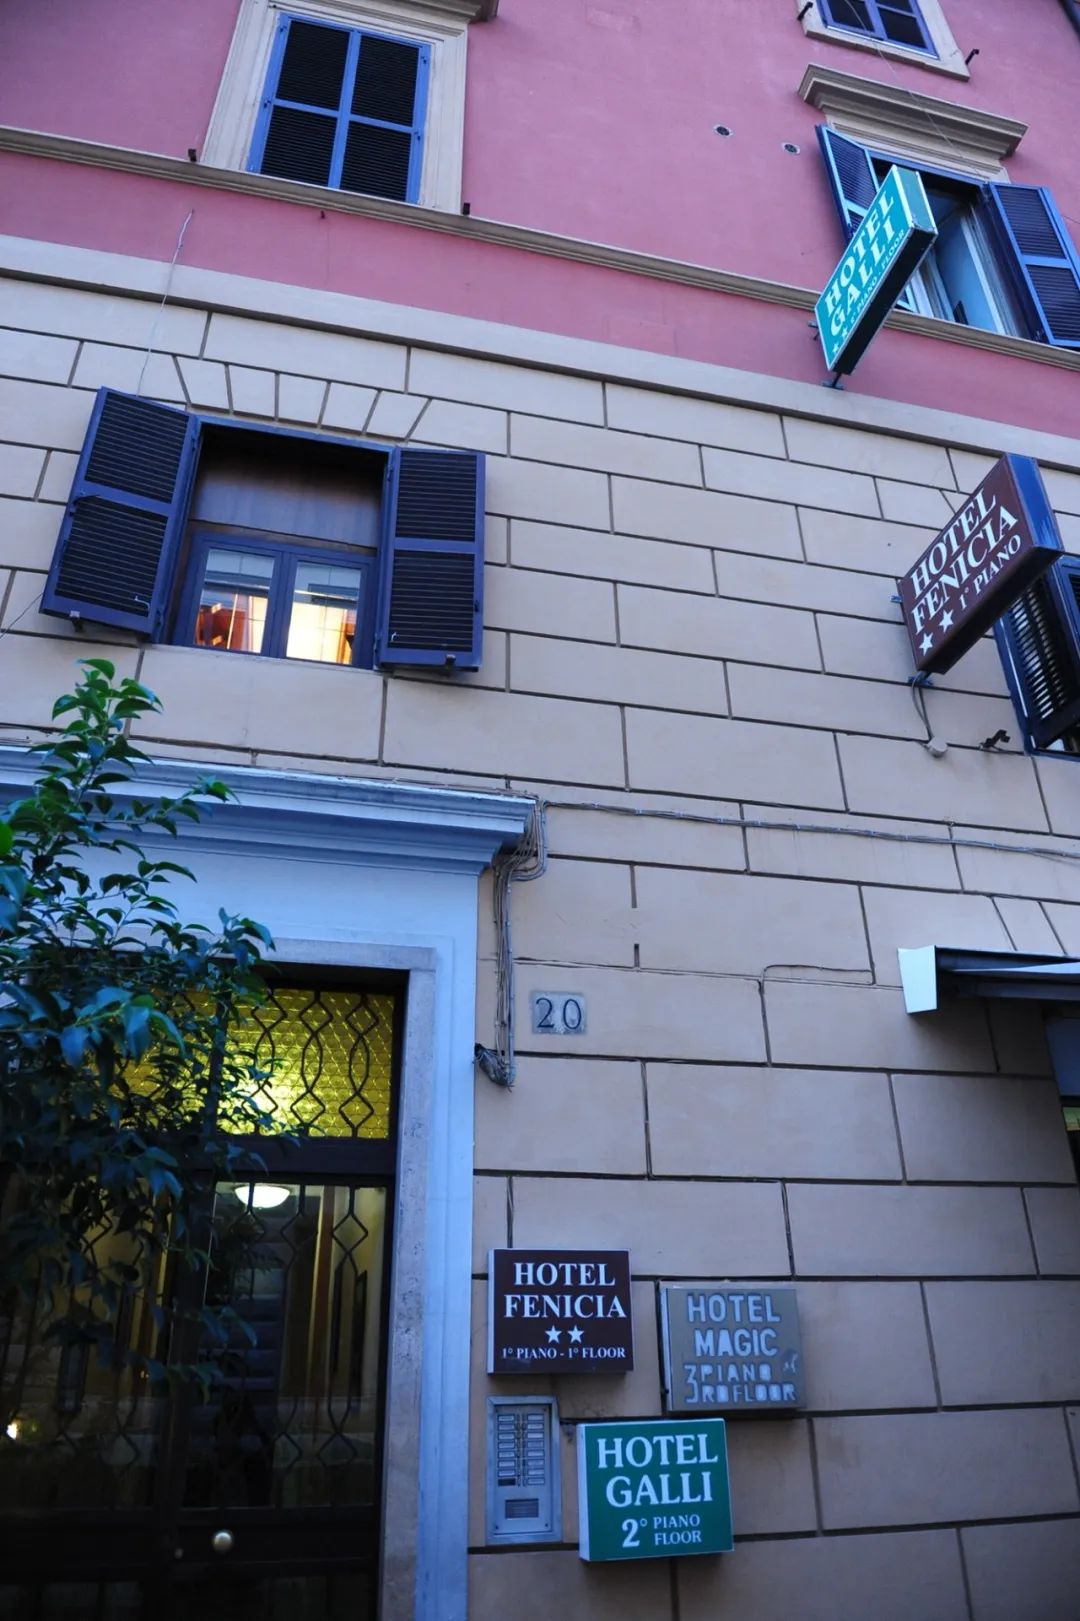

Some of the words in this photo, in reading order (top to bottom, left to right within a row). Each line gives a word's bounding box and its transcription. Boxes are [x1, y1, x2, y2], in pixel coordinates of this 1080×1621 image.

[824, 190, 894, 316] HOTEL
[830, 215, 895, 337] GALLI
[856, 276, 878, 315] PIANO
[881, 228, 905, 270] FLOOR
[911, 488, 996, 599] HOTEL
[911, 505, 1018, 635] FENICIA
[973, 534, 1021, 595] PIANO
[536, 997, 582, 1030] 20
[513, 1262, 616, 1287] HOTEL
[504, 1294, 627, 1319] FENICIA
[687, 1295, 781, 1322] HOTEL
[516, 1347, 557, 1359] PIANO
[582, 1347, 626, 1359] FLOOR
[695, 1328, 778, 1357] MAGIC
[701, 1363, 772, 1382] PIANO
[597, 1433, 719, 1469] HOTEL
[606, 1471, 713, 1508] GALLI
[653, 1513, 701, 1530] PIANO
[654, 1529, 702, 1547] FLOOR
